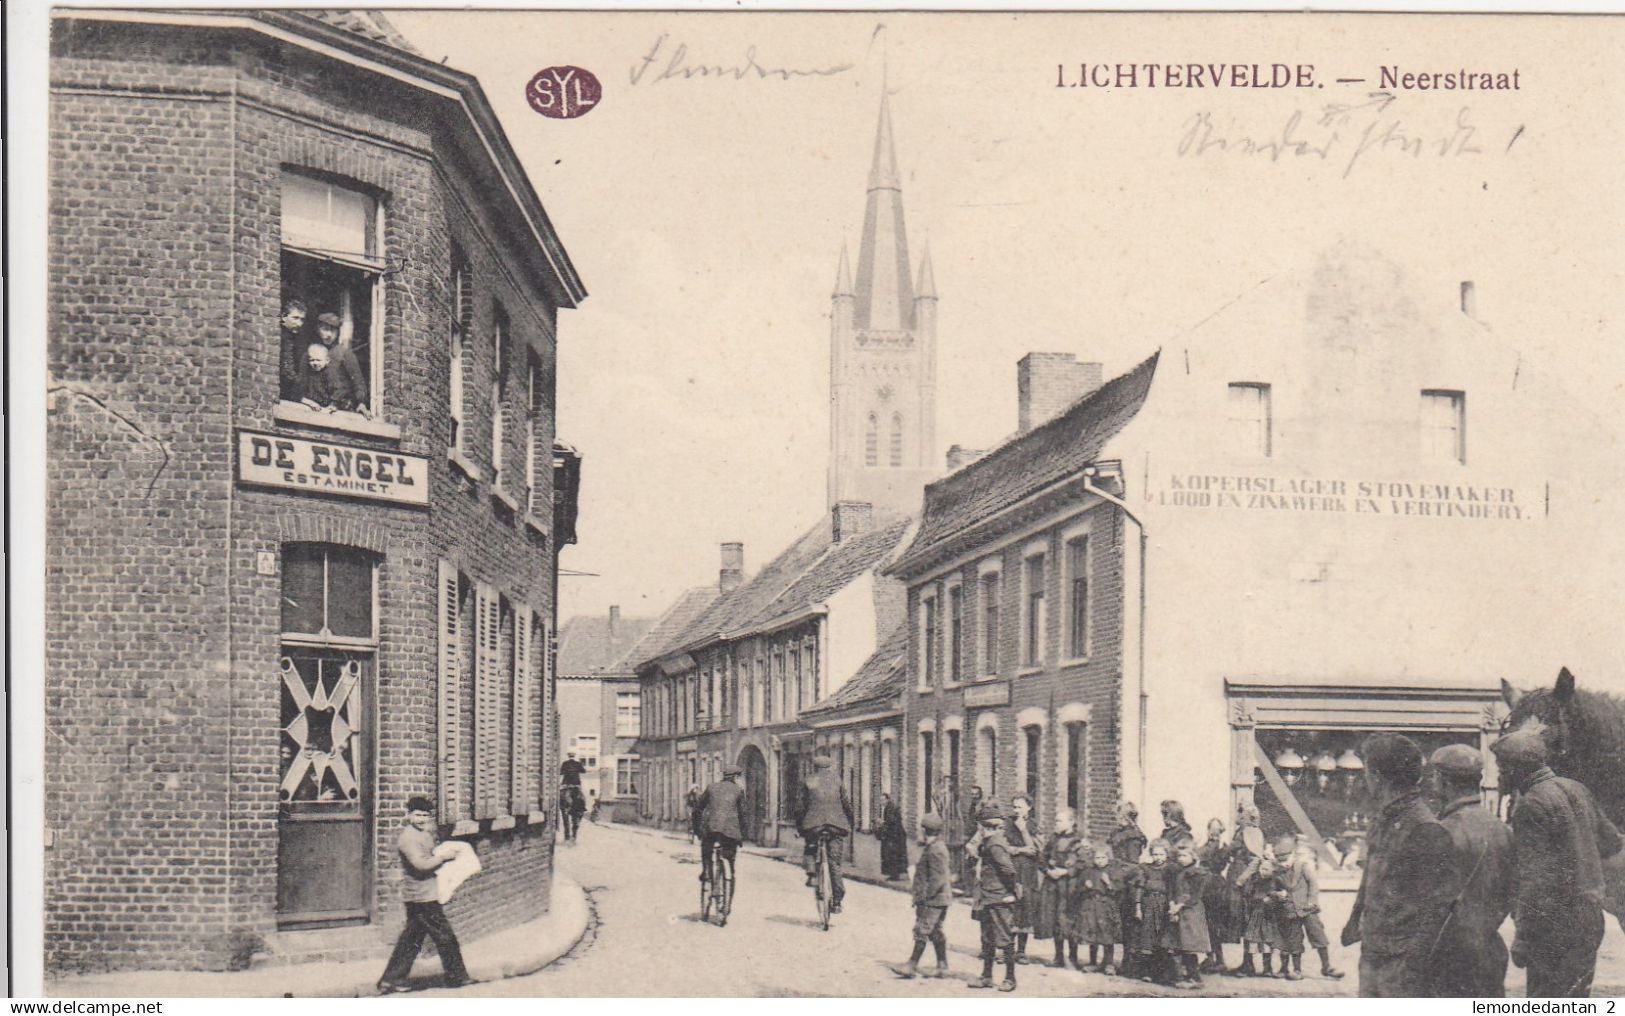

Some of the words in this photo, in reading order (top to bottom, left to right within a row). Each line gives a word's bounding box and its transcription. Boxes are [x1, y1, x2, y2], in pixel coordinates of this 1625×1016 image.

[1055, 63, 1325, 89] LICHTERVELDE.
[1378, 64, 1521, 91] Neerstraat
[533, 69, 595, 117] SYL
[250, 436, 295, 470] DE
[311, 445, 415, 487] ENGEL
[283, 471, 393, 495] ESTAMINET.
[1170, 474, 1347, 496] KOPERSLAGER
[1357, 481, 1515, 504] STOVEMAKER
[1159, 490, 1212, 508] LOOD
[1216, 492, 1242, 509] EN
[1247, 494, 1347, 513] ZINKWERK
[1354, 499, 1381, 514] EN
[1391, 500, 1531, 521] VERTINDERY.
